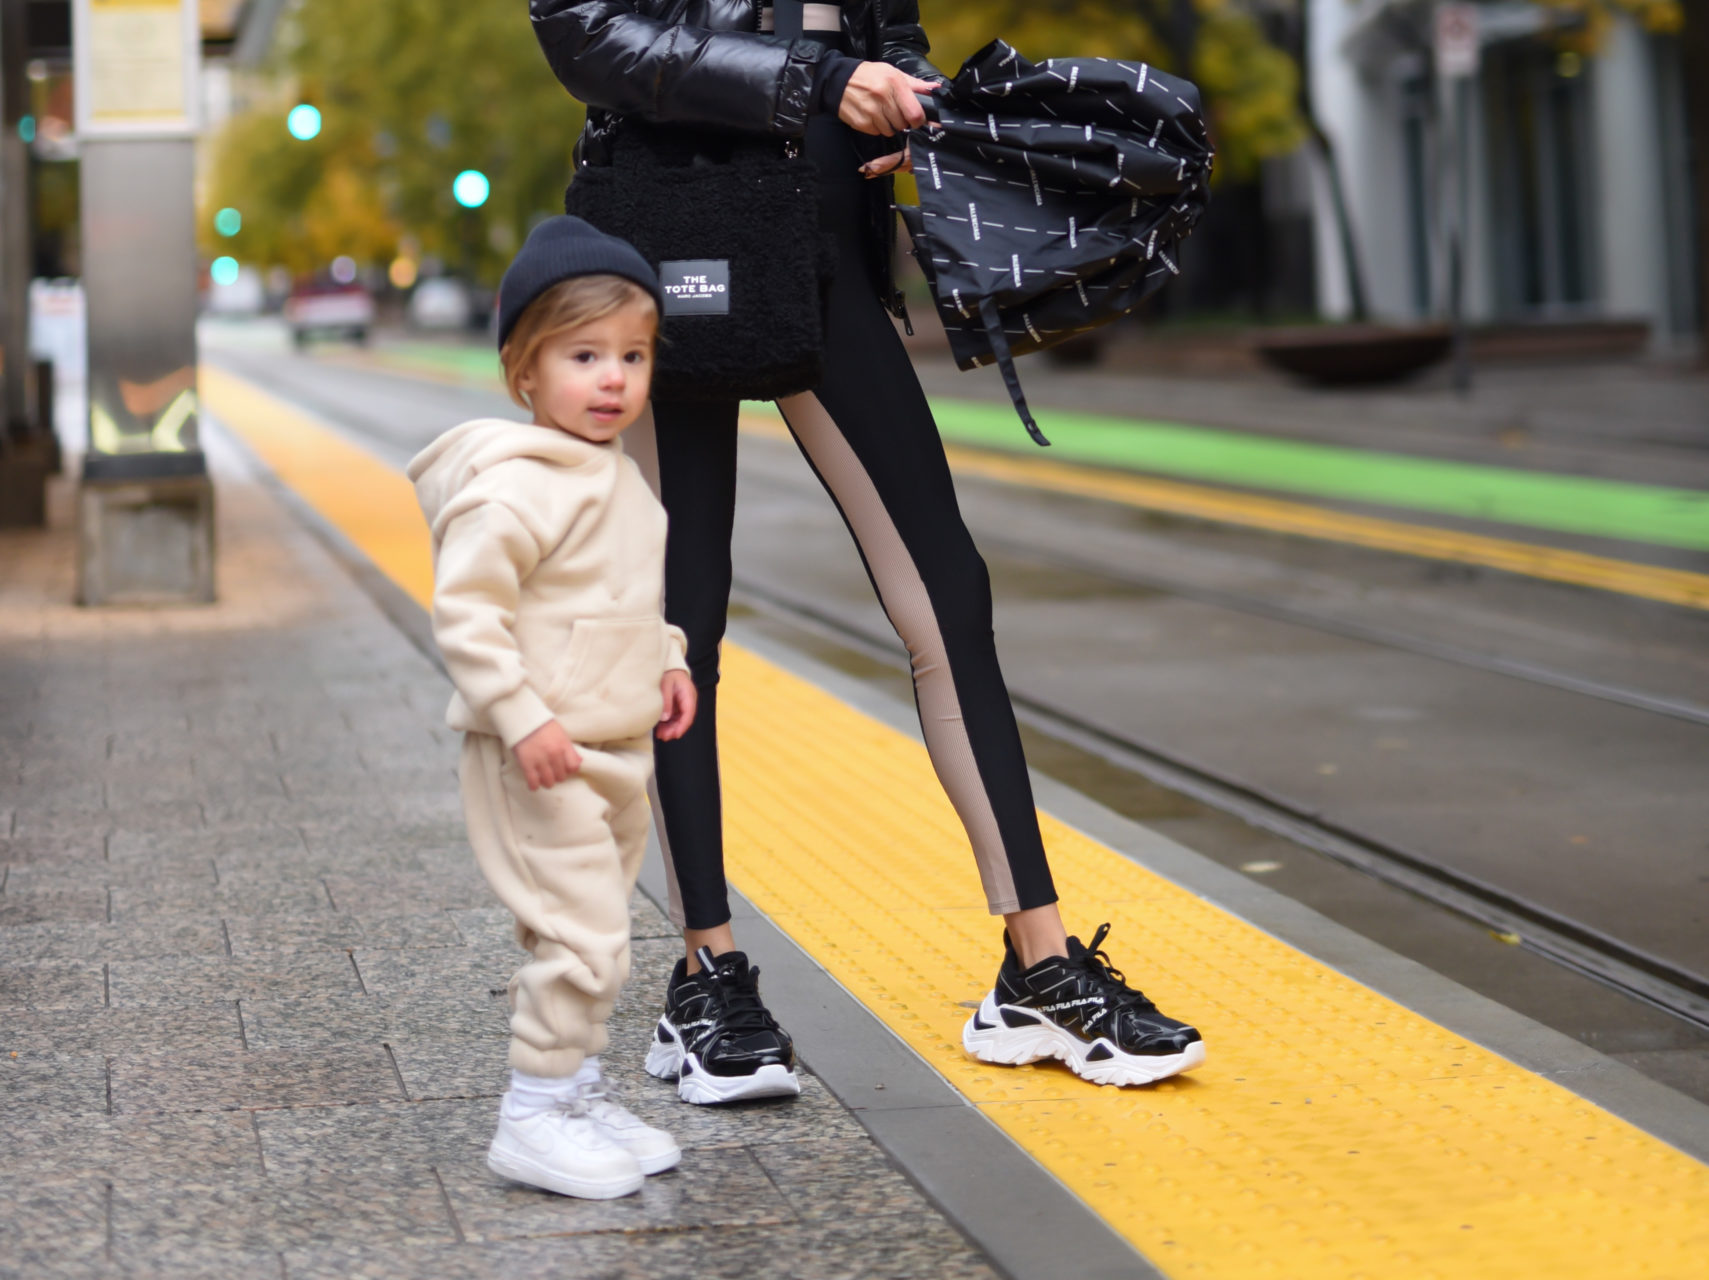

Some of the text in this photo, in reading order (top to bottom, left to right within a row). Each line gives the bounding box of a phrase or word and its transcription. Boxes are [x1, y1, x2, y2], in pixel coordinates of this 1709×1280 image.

[928, 152, 942, 190] BALENCIAGA
[968, 202, 981, 241] BALENCIAGA
[683, 275, 707, 283] THE
[665, 284, 725, 294] TOTE BAG
[1056, 1002, 1071, 1010] FILA
[1071, 999, 1087, 1007] FILA
